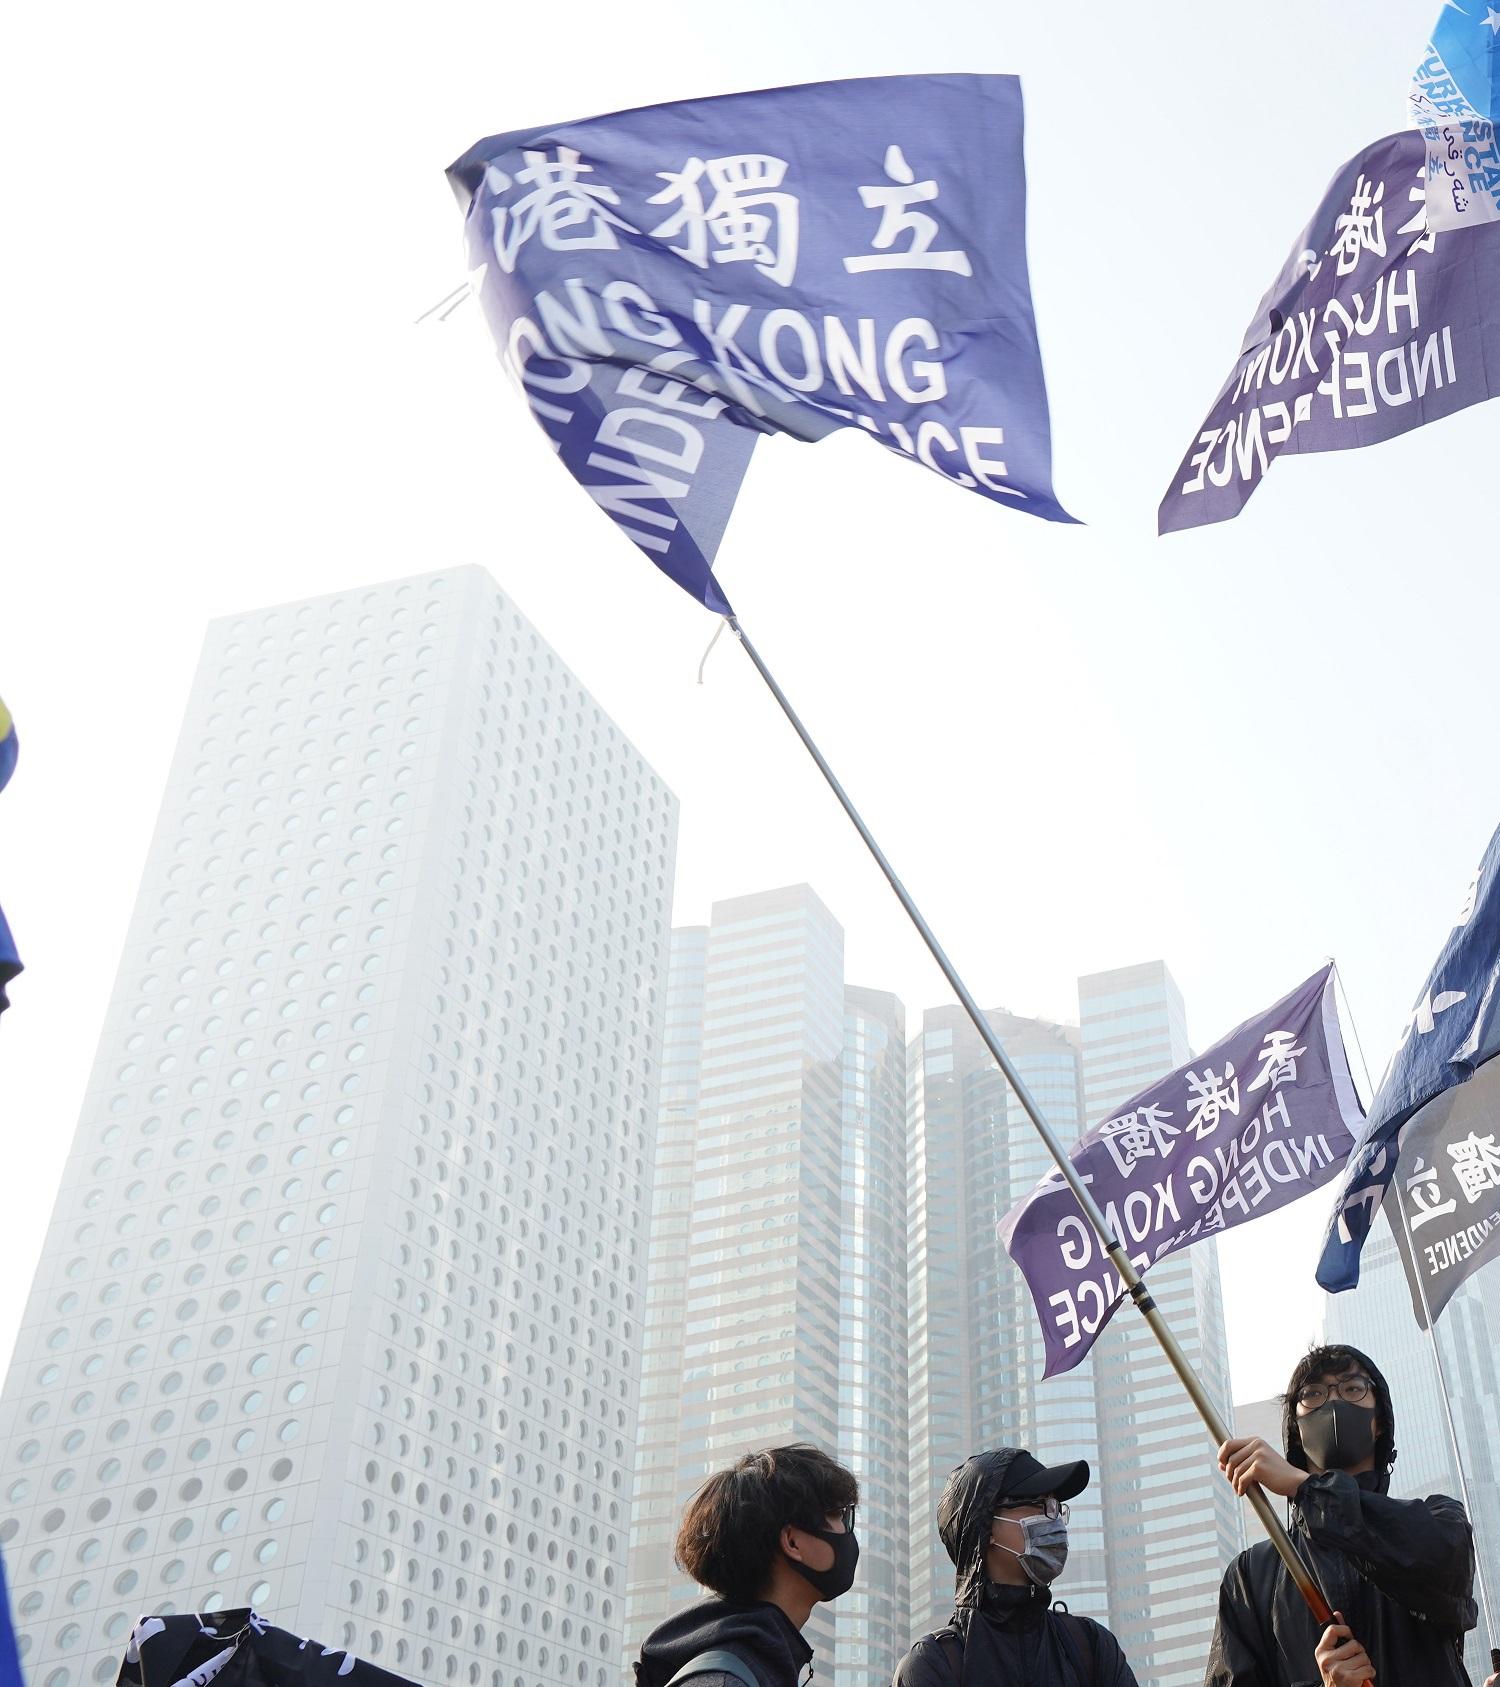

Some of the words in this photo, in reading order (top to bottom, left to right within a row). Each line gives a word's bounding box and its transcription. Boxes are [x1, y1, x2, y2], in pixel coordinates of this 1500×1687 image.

[484, 143, 973, 288] 港獨立
[692, 299, 948, 417] KONG
